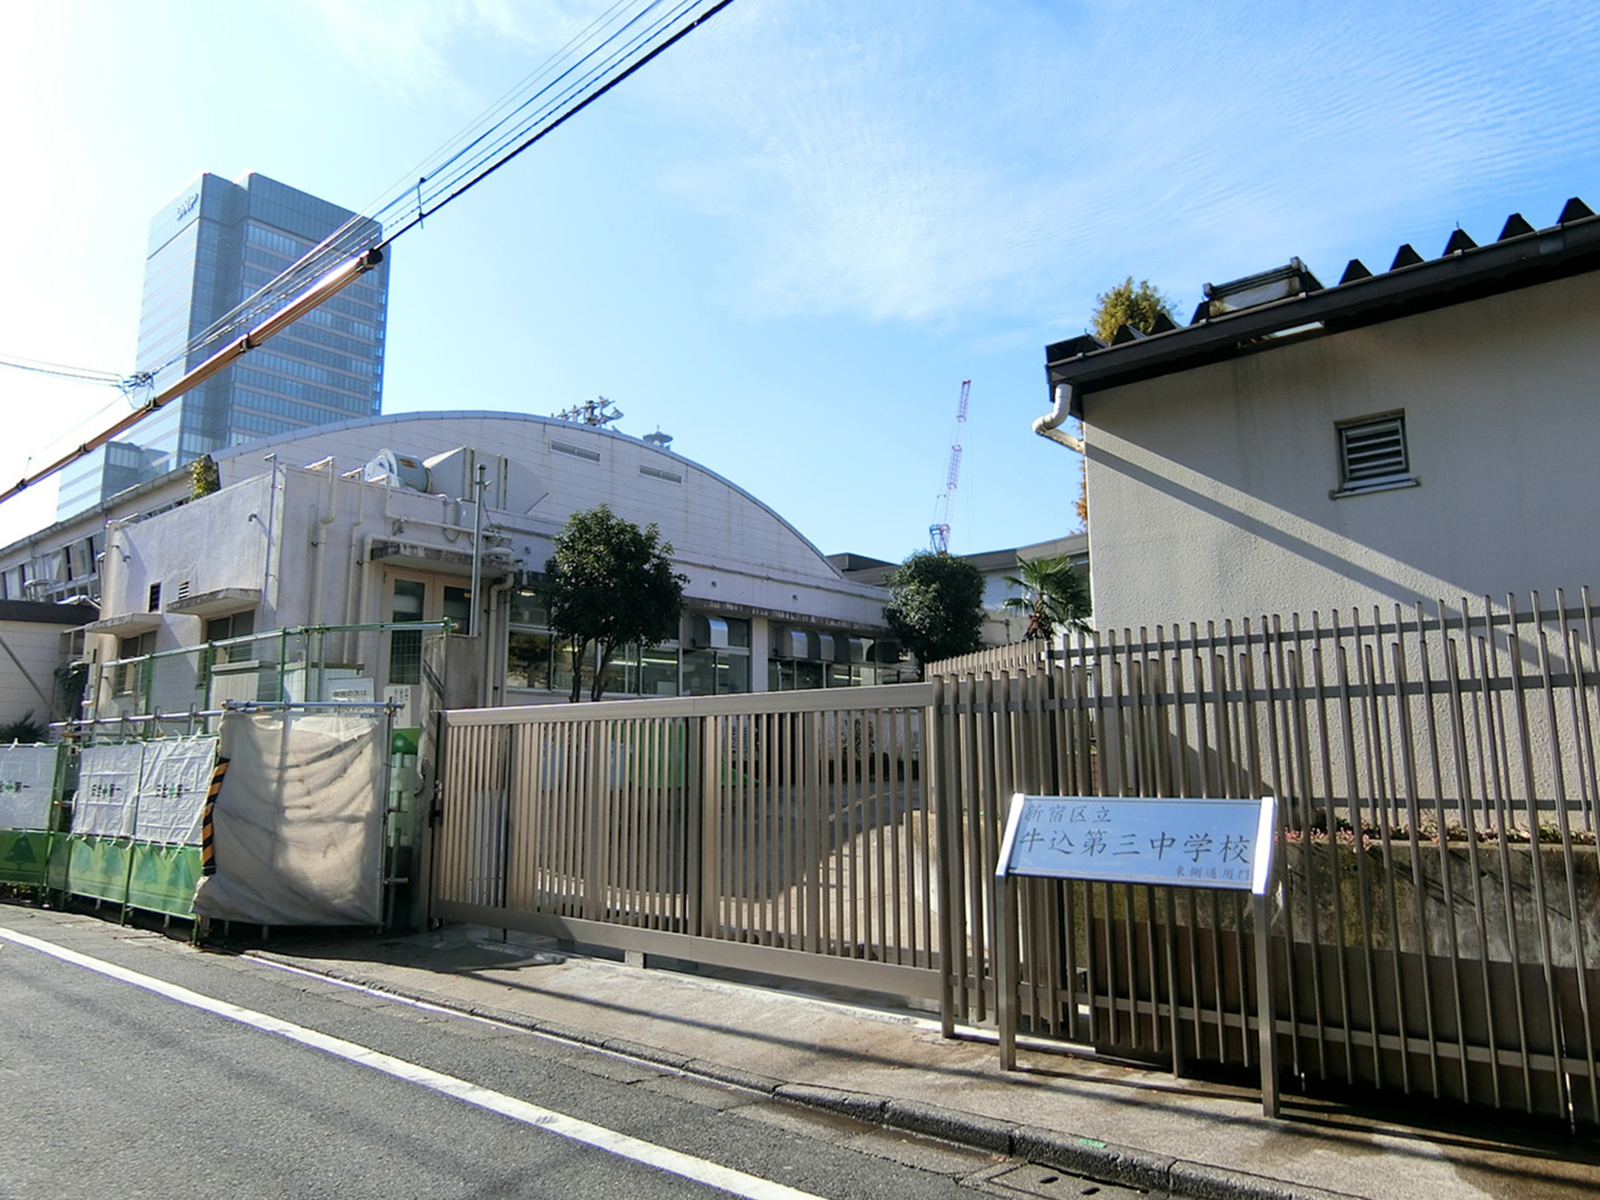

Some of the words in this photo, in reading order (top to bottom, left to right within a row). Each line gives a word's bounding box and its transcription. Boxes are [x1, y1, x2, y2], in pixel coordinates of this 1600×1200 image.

[1024, 804, 1112, 823] 新宿区立
[1019, 827, 1251, 864] 牛込第三中学校
